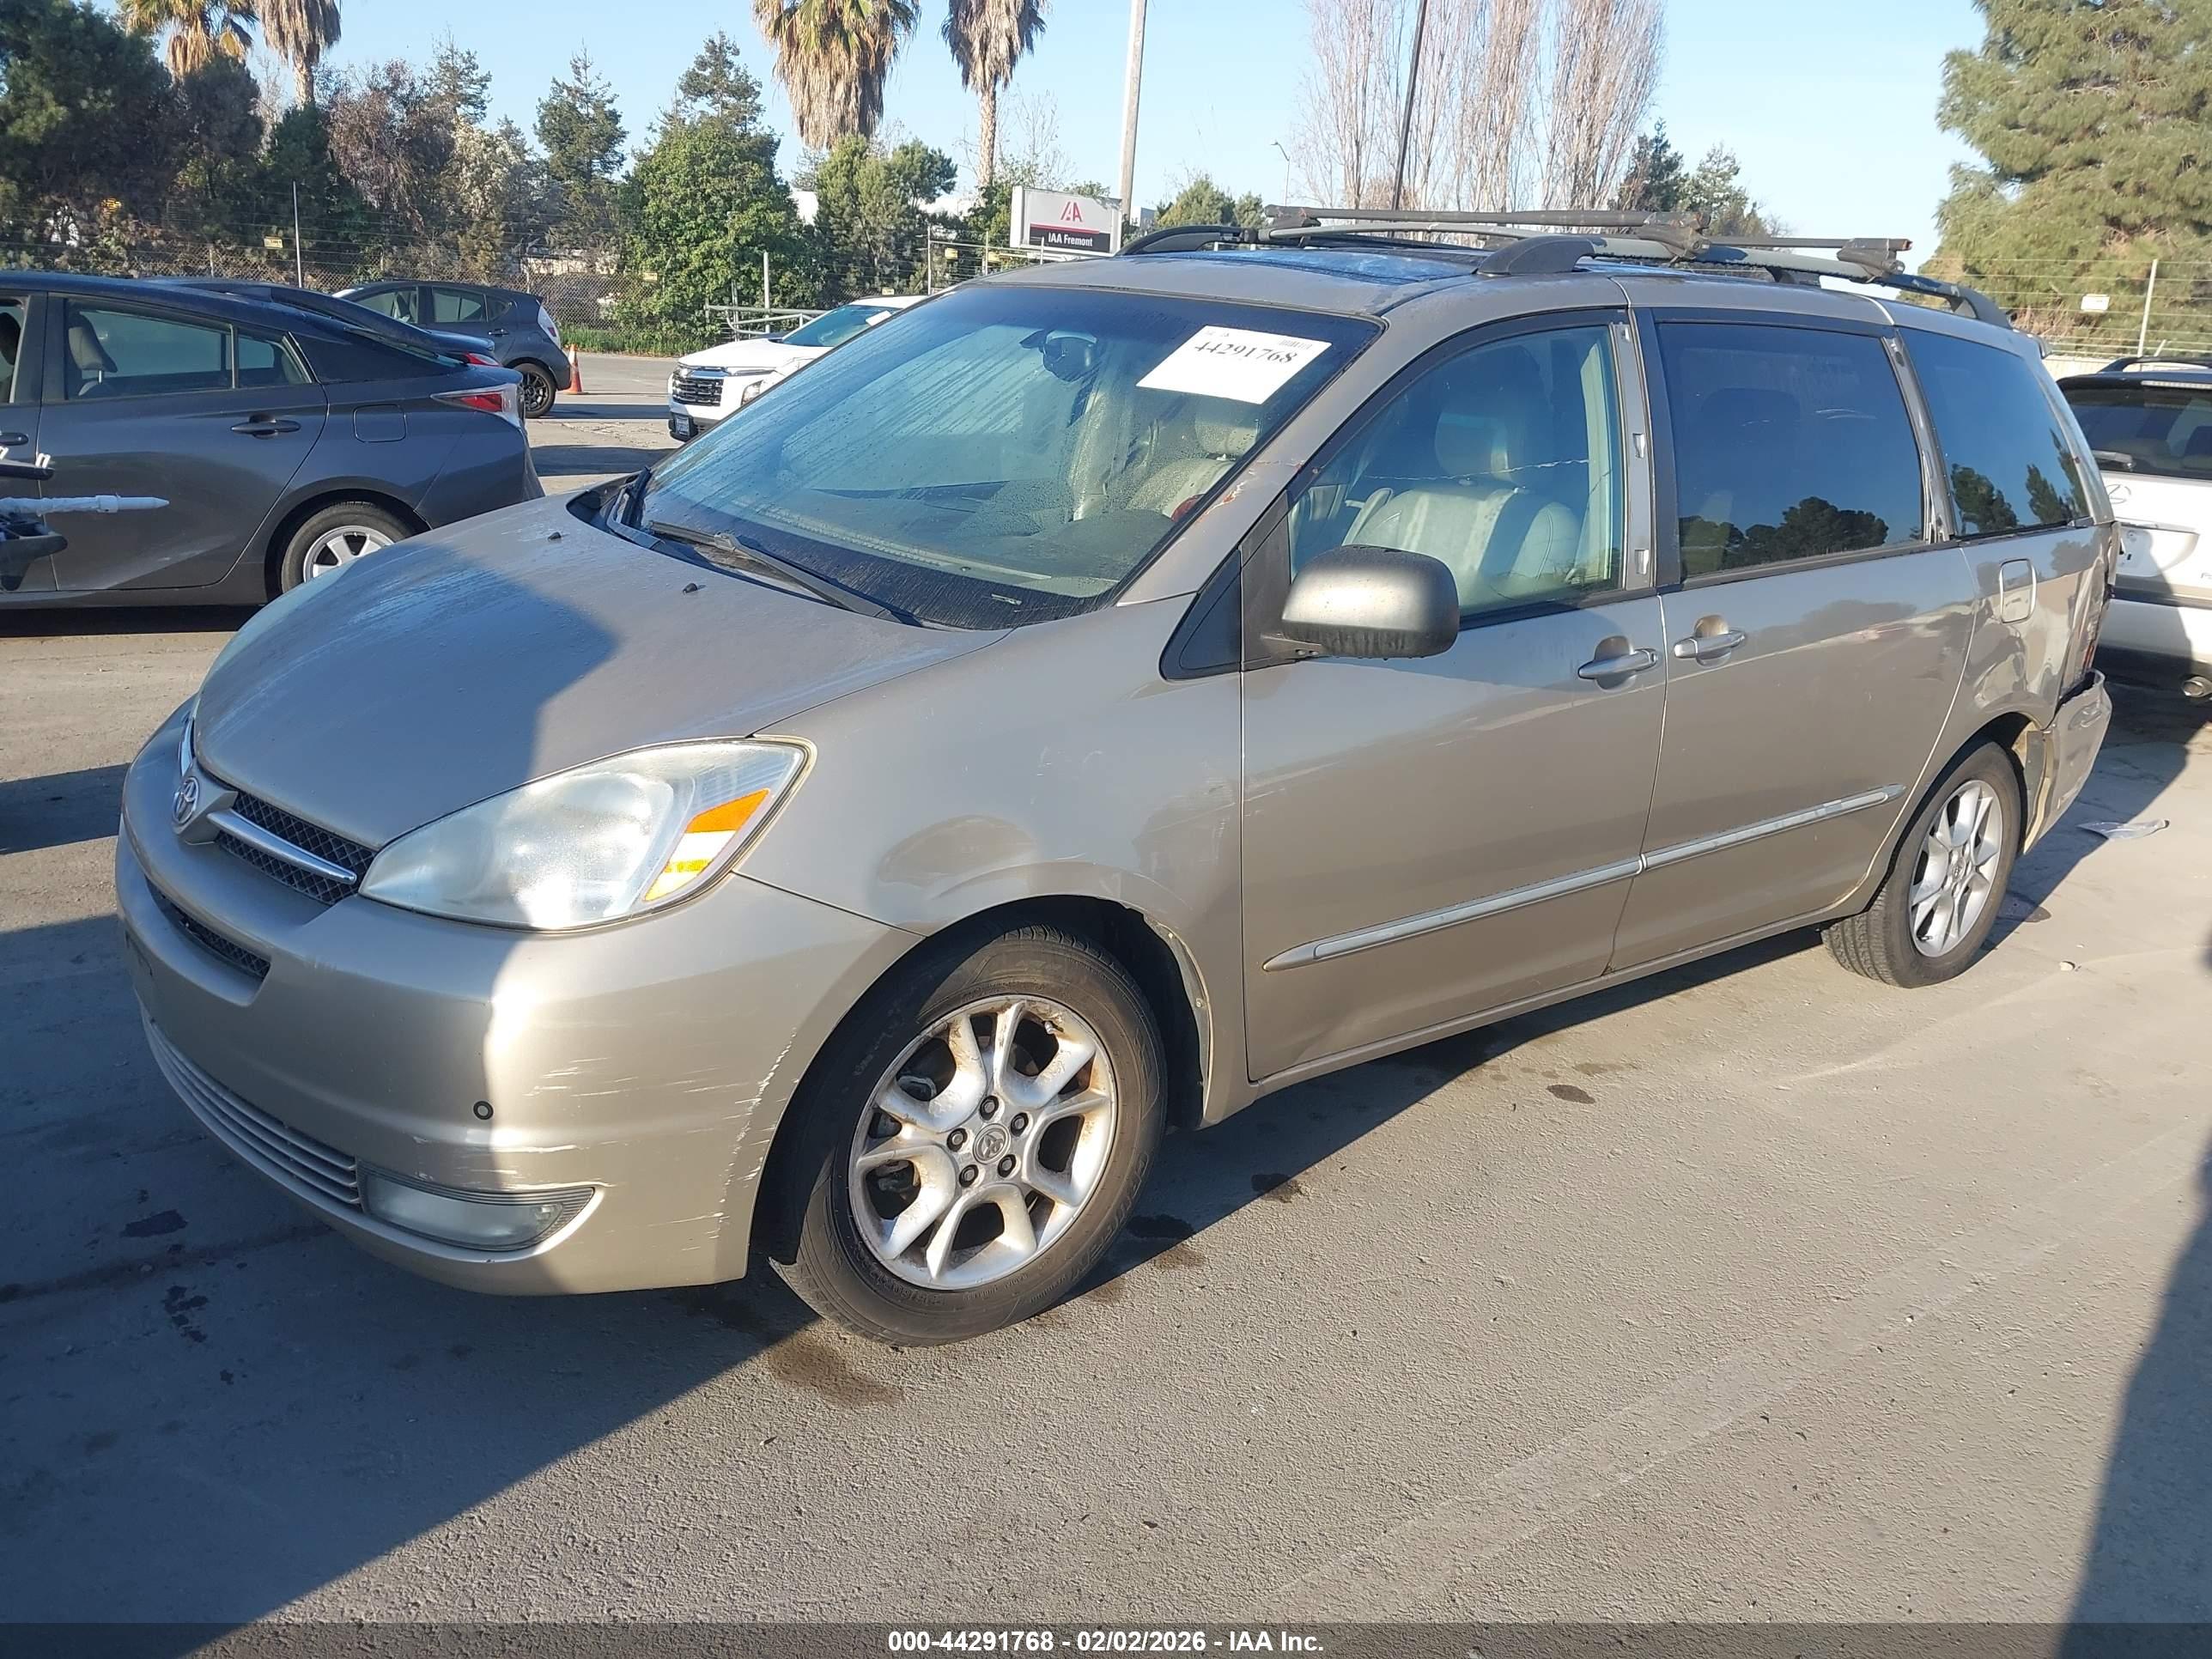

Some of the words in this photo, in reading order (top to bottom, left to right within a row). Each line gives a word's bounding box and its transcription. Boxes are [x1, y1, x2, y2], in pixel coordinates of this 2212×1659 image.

[1048, 232, 1063, 244] IAA
[1064, 235, 1093, 247] Fremont
[1194, 341, 1298, 364] 44291768
